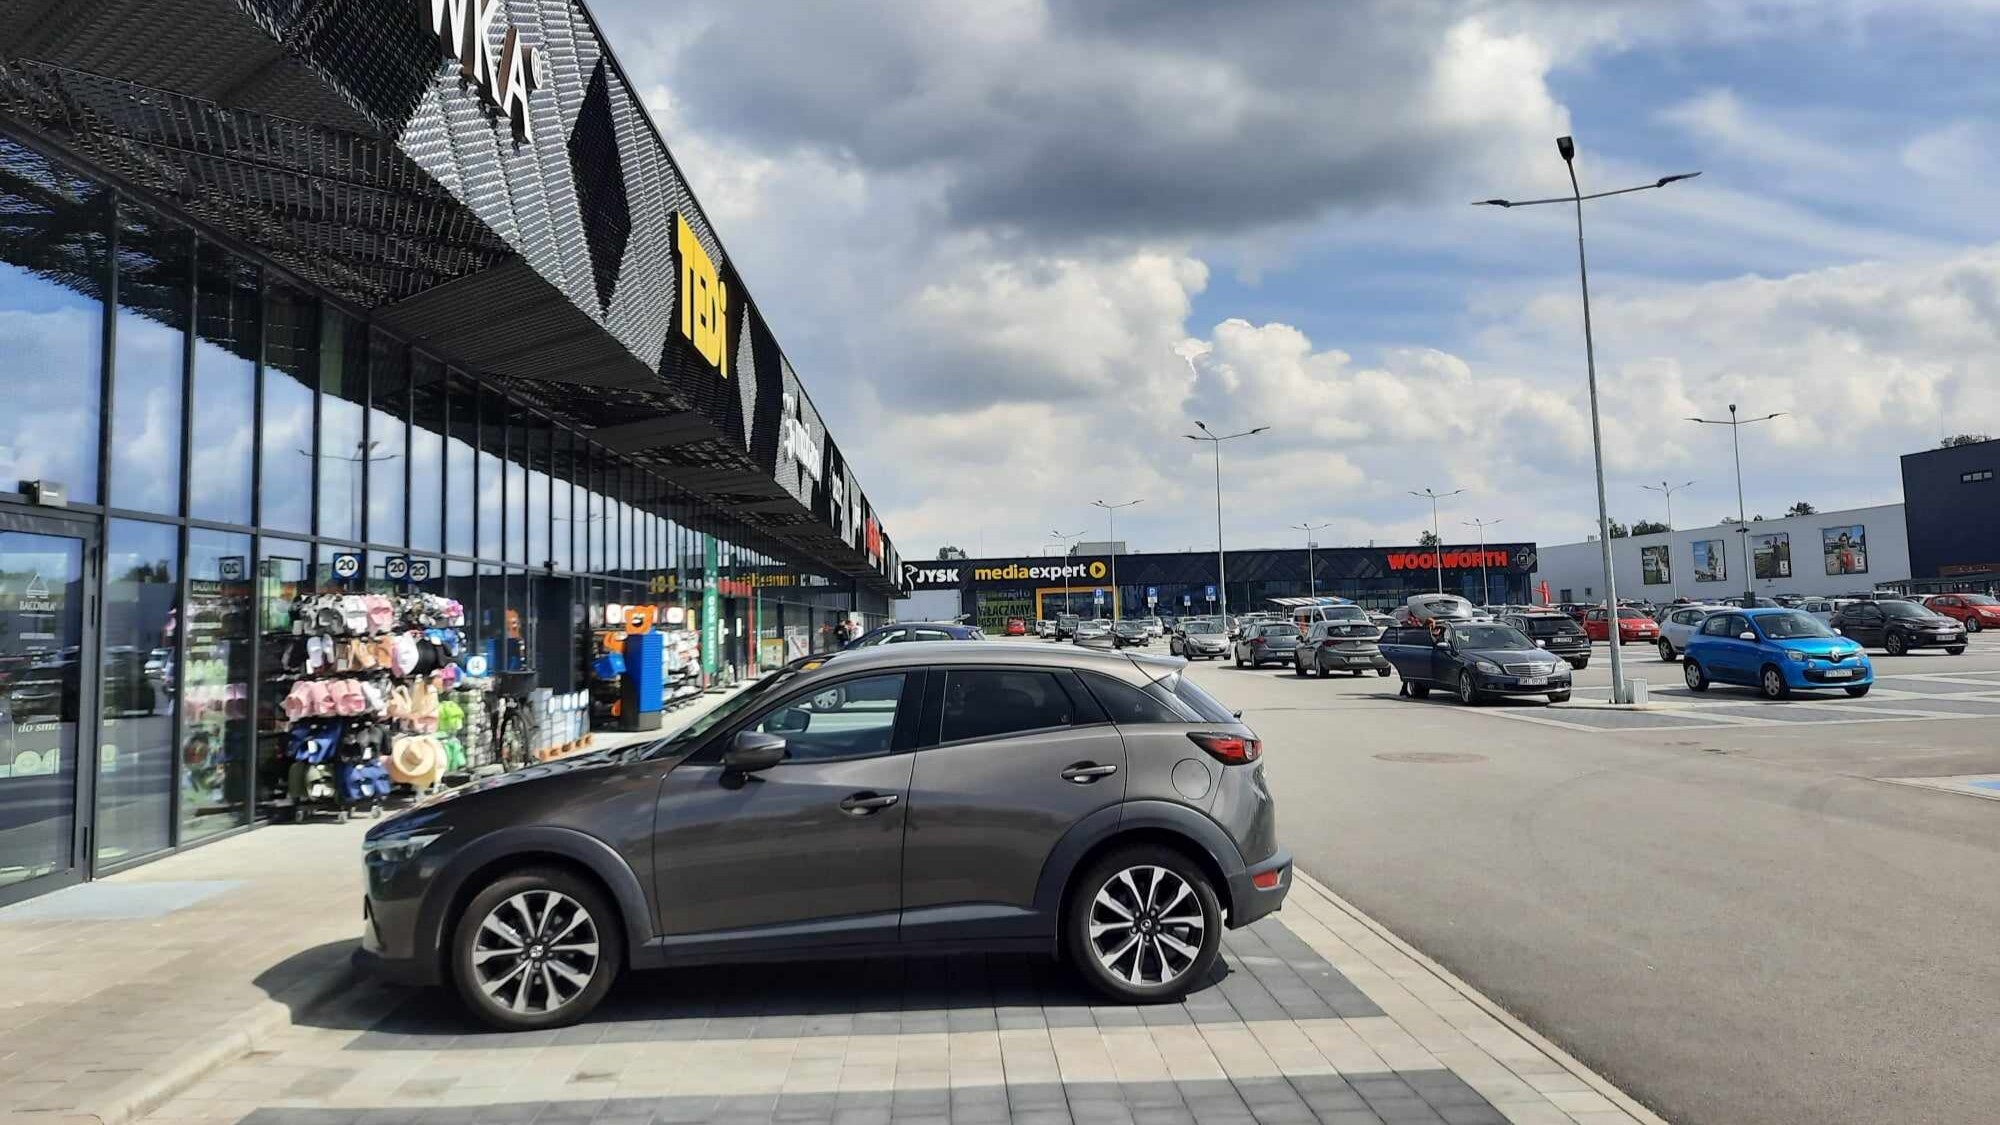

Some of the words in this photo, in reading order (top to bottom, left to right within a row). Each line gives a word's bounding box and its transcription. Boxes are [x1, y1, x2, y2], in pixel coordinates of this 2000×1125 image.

[677, 211, 727, 379] TEDi
[338, 559, 355, 571] 20
[1387, 551, 1508, 570] WOOLWORTH
[390, 562, 405, 573] 20
[412, 566, 426, 576] 20
[975, 563, 1087, 582] mediaexpert
[916, 568, 960, 583] JYSK
[18, 722, 33, 733] do
